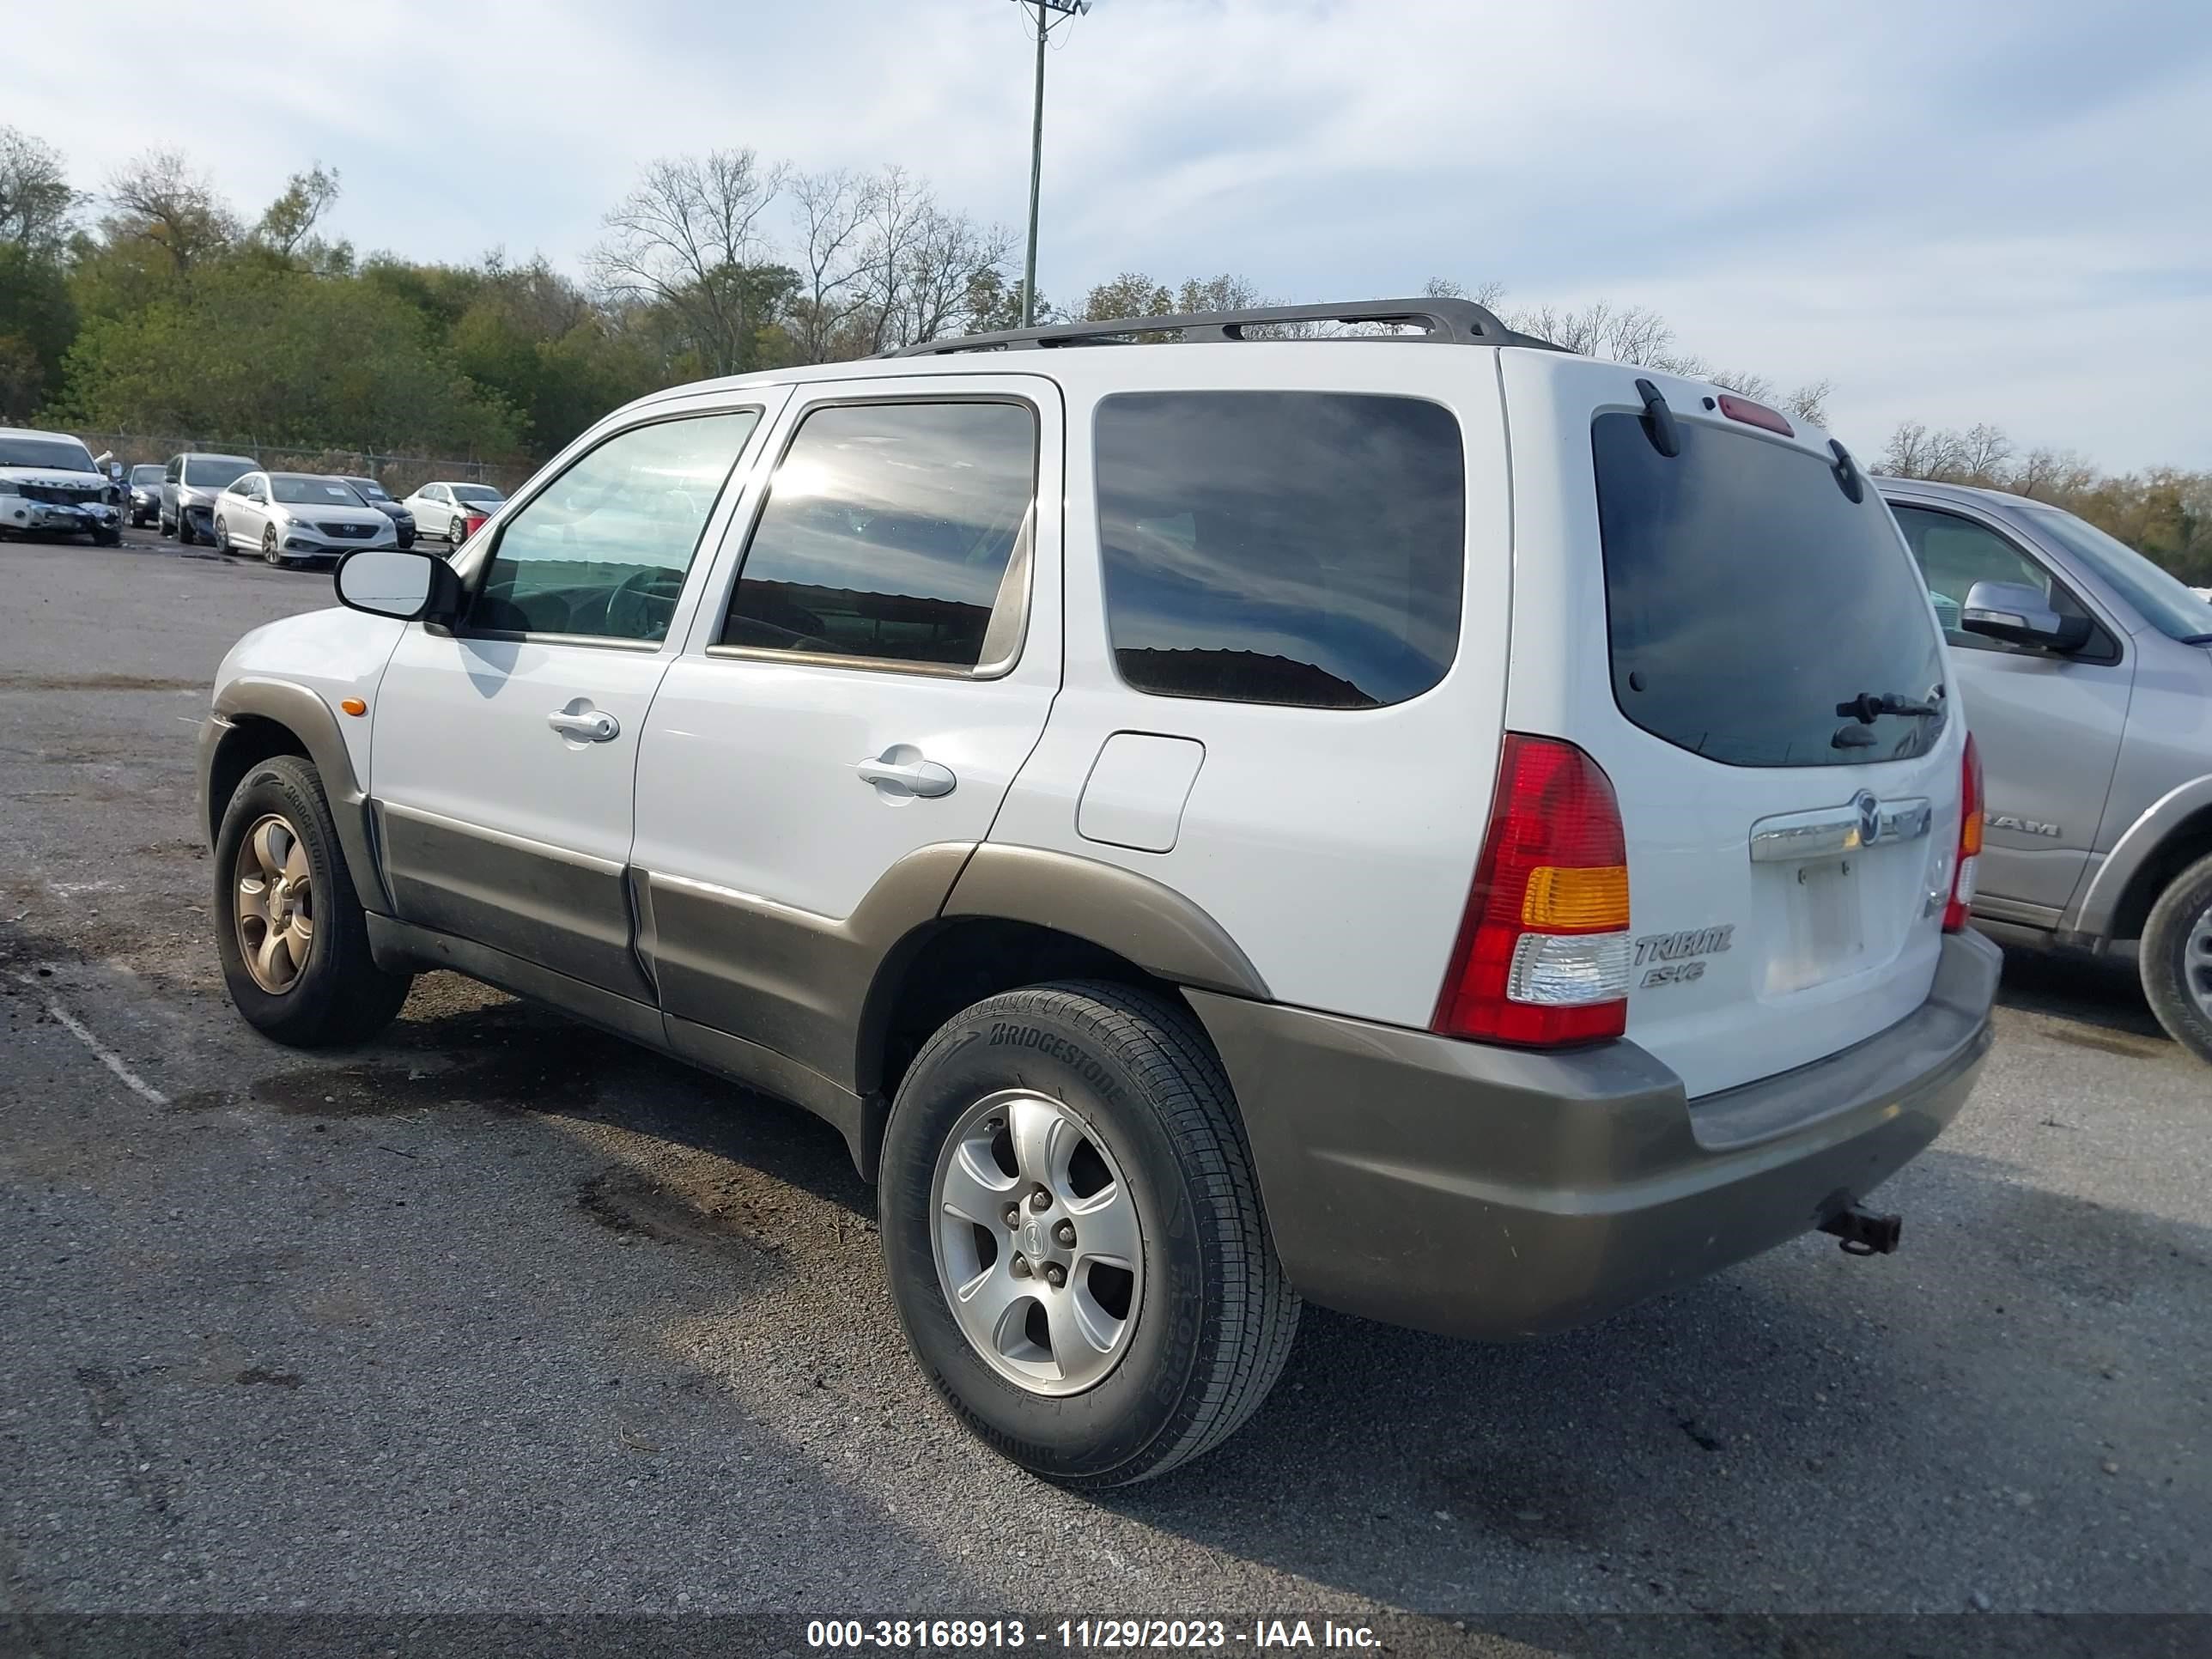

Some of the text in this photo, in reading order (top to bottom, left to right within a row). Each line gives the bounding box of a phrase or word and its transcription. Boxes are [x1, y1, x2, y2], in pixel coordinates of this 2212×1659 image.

[285, 786, 324, 878] BRIDGESTONE
[1634, 925, 1735, 966] TRIBUTE
[989, 1023, 1127, 1105] BRIDGESTONE
